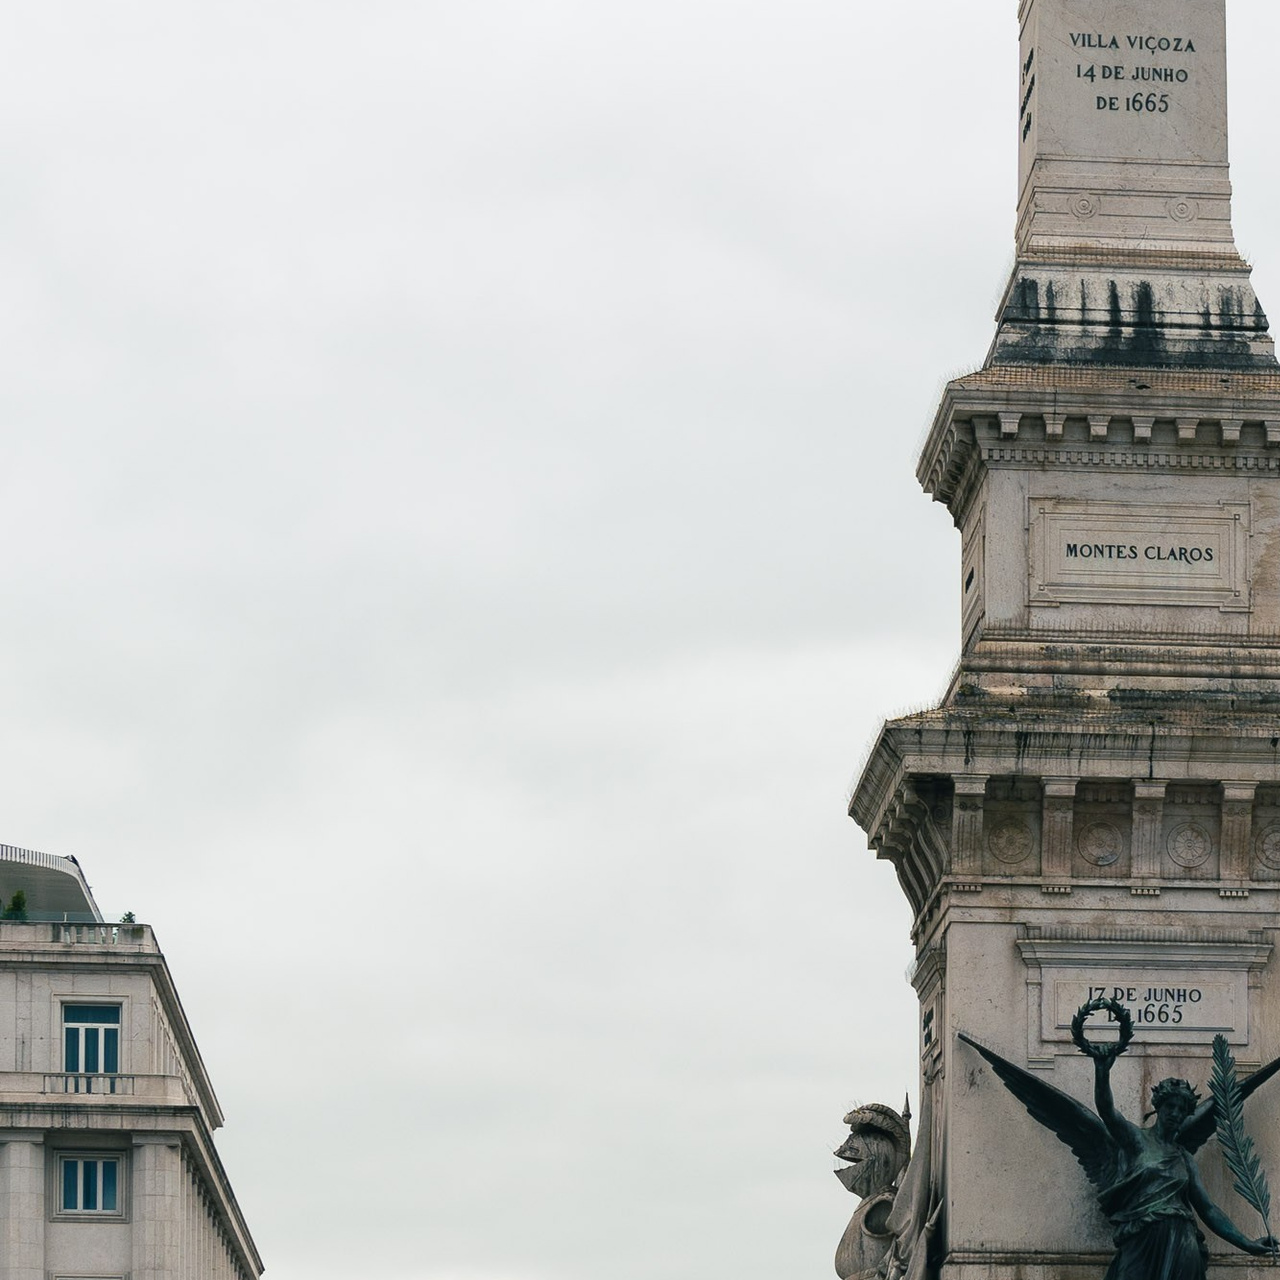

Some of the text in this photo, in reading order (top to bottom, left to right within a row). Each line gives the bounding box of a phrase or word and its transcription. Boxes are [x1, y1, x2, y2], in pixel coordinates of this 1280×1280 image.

[1069, 33, 1196, 55] VILLA VIÇOZA
[1077, 64, 1188, 82] 14 DE JUNHO
[1096, 92, 1169, 113] DE 1665
[1066, 543, 1214, 564] MONTES CLAROS
[1088, 987, 1202, 1003] 17 DE JUNHO
[1138, 1003, 1183, 1023] 1665
